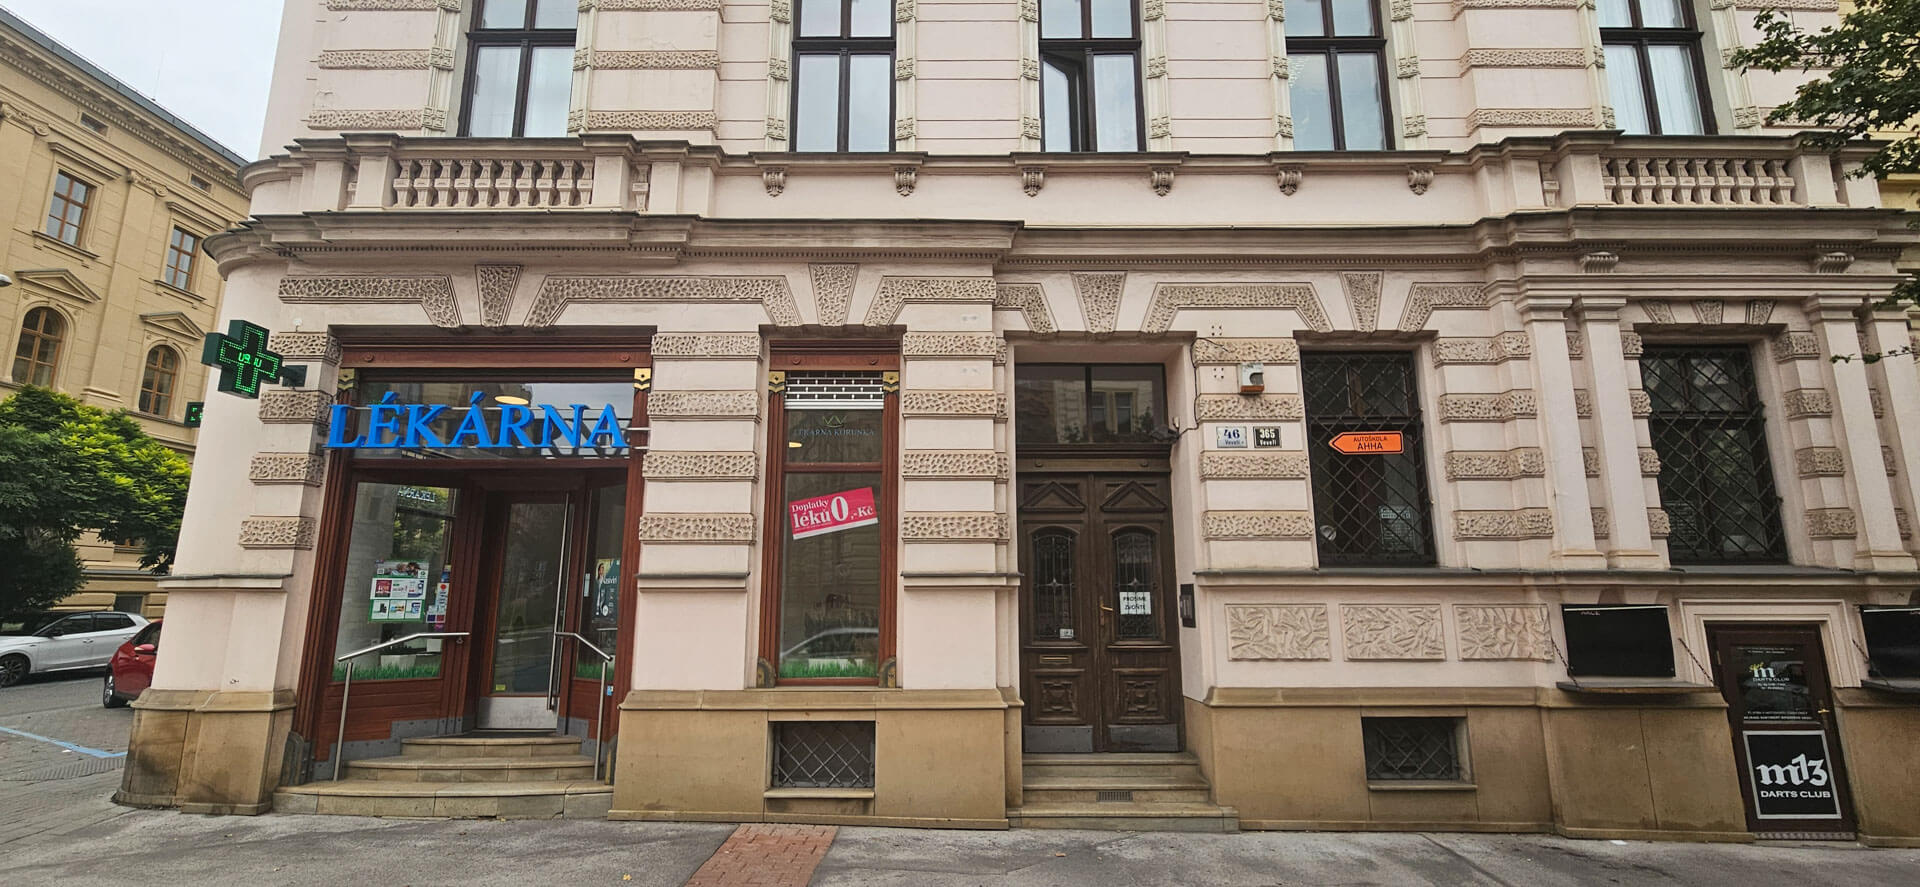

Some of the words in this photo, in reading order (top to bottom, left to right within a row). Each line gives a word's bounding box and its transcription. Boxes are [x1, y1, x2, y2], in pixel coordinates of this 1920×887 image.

[326, 391, 627, 448] LÉKÁRNA
[1224, 428, 1240, 439] 46
[1260, 428, 1276, 439] 365
[1357, 441, 1384, 450] AHHA
[791, 499, 829, 513] Doplatky
[793, 508, 832, 529] léků
[1756, 753, 1828, 786] m13
[1761, 790, 1798, 798] DARTS
[1799, 790, 1831, 798] CLUB
